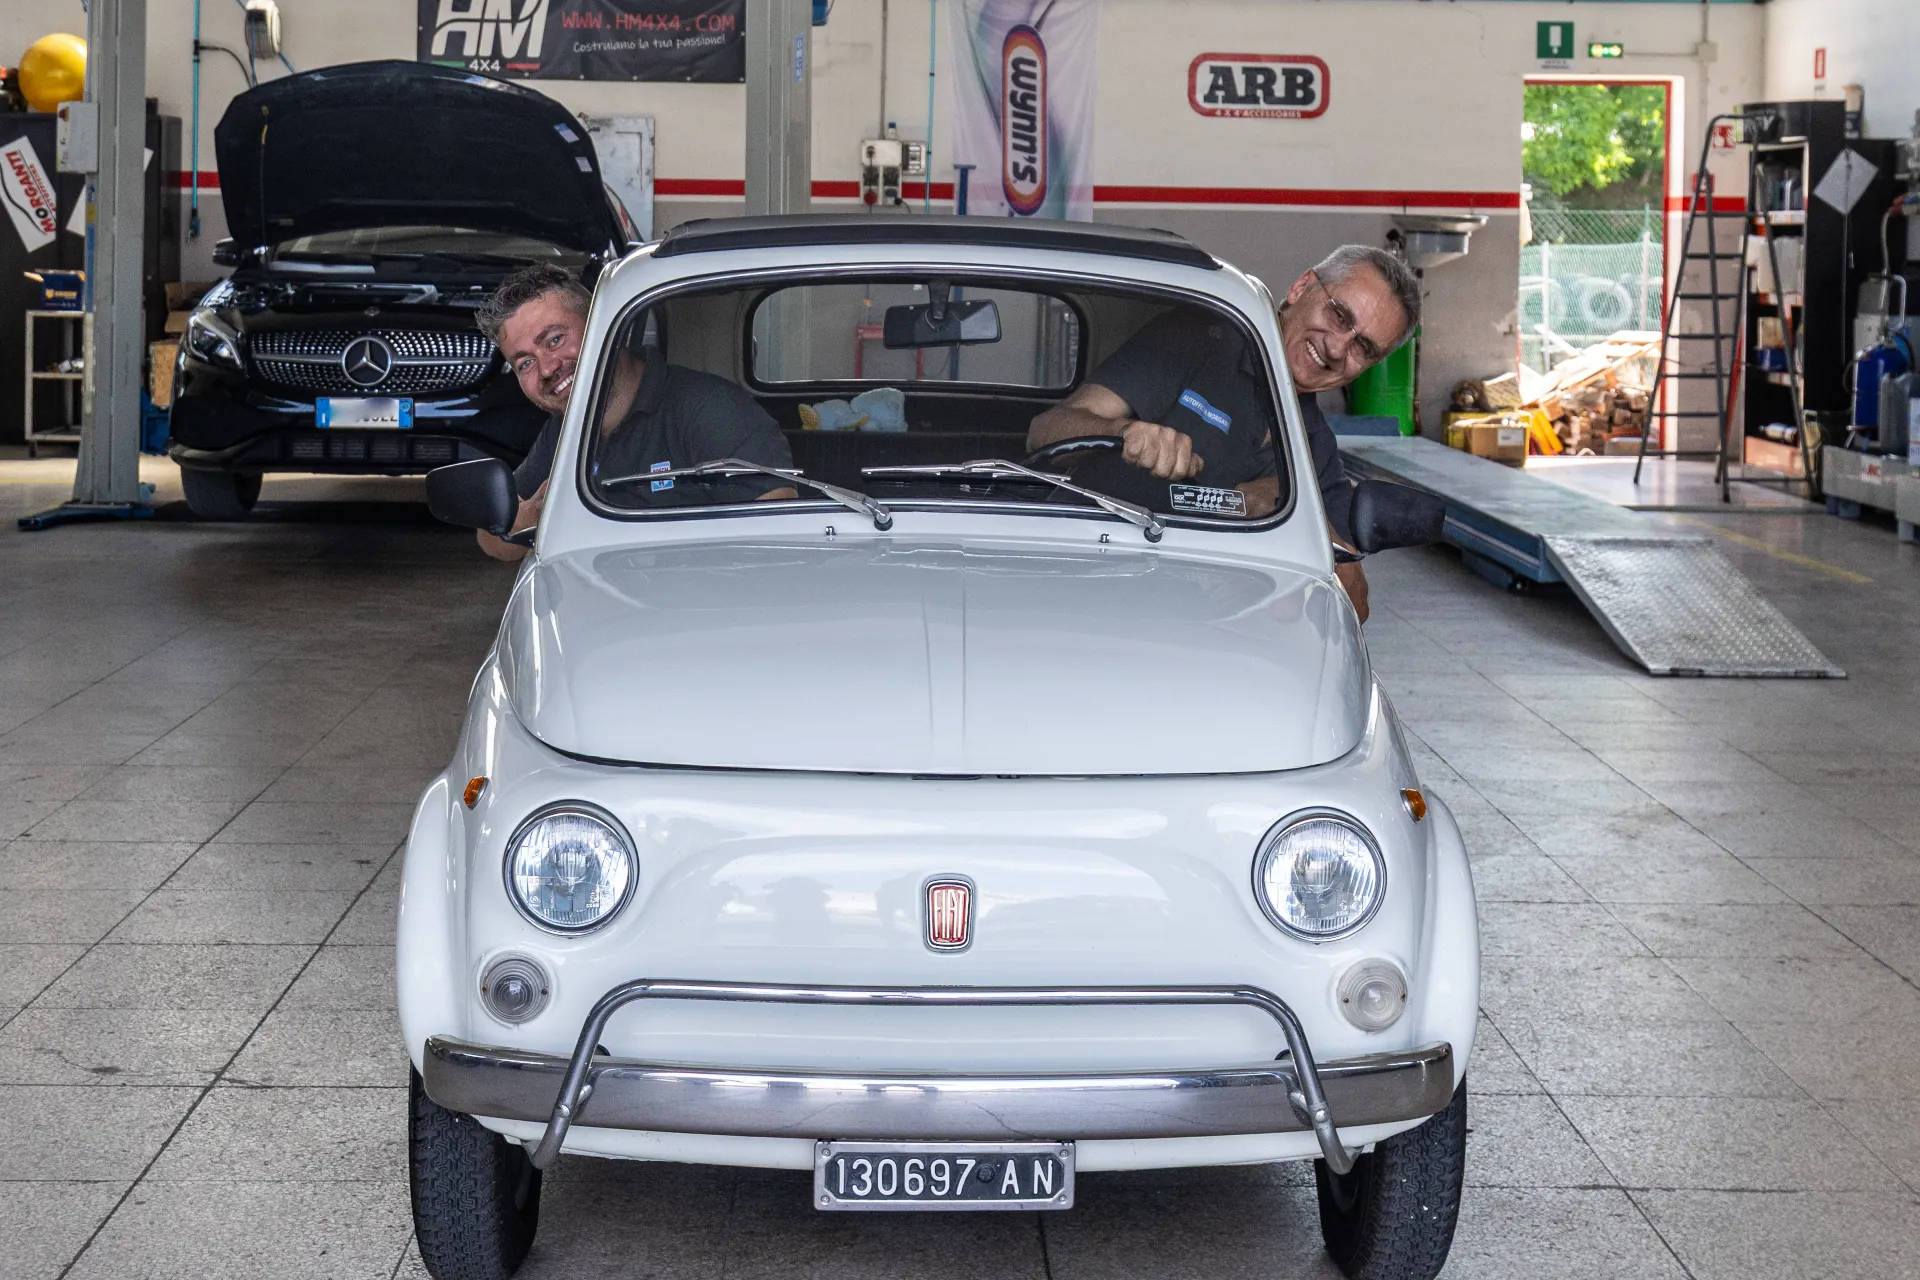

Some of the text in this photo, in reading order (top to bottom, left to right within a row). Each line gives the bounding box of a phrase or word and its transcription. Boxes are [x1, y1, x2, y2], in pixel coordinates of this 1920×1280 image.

[431, 0, 549, 58] HM
[573, 34, 726, 53] Costruiamo la tua passione!
[469, 59, 502, 72] 4X4
[1203, 65, 1316, 106] ARB
[1243, 109, 1302, 118] ACCESSORIES
[6, 150, 56, 233] MORGANTI
[933, 889, 966, 939] FIAT
[836, 1158, 976, 1196] 130697
